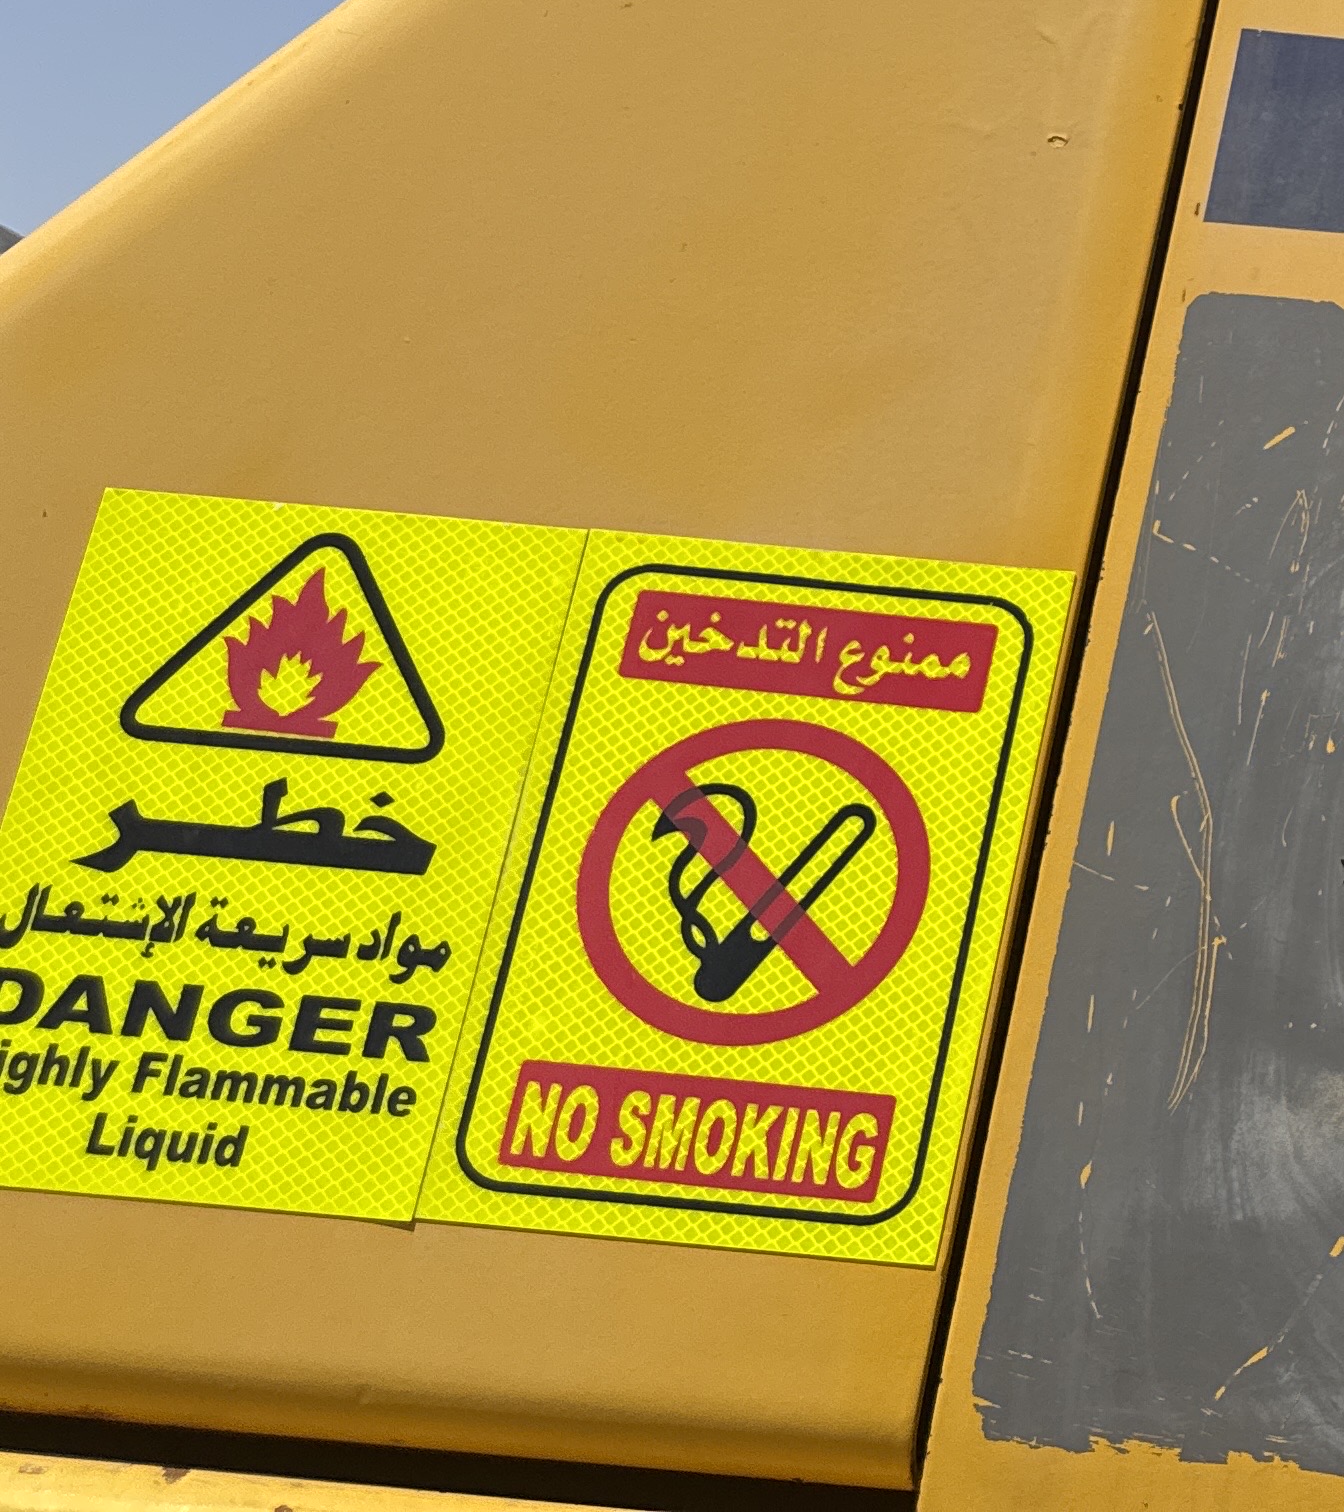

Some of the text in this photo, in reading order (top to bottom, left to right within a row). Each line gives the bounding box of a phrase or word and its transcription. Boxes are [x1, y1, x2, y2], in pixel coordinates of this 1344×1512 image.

[637, 609, 972, 696] ممنوع التدخين
[69, 777, 437, 876] خطر
[194, 896, 353, 976] سريعة
[356, 910, 452, 985] مواد
[0, 967, 438, 1063] DANGER
[0, 1038, 418, 1117] ighly Flammable
[85, 1112, 250, 1172] Liquid
[509, 1080, 880, 1190] NO SMOKING
